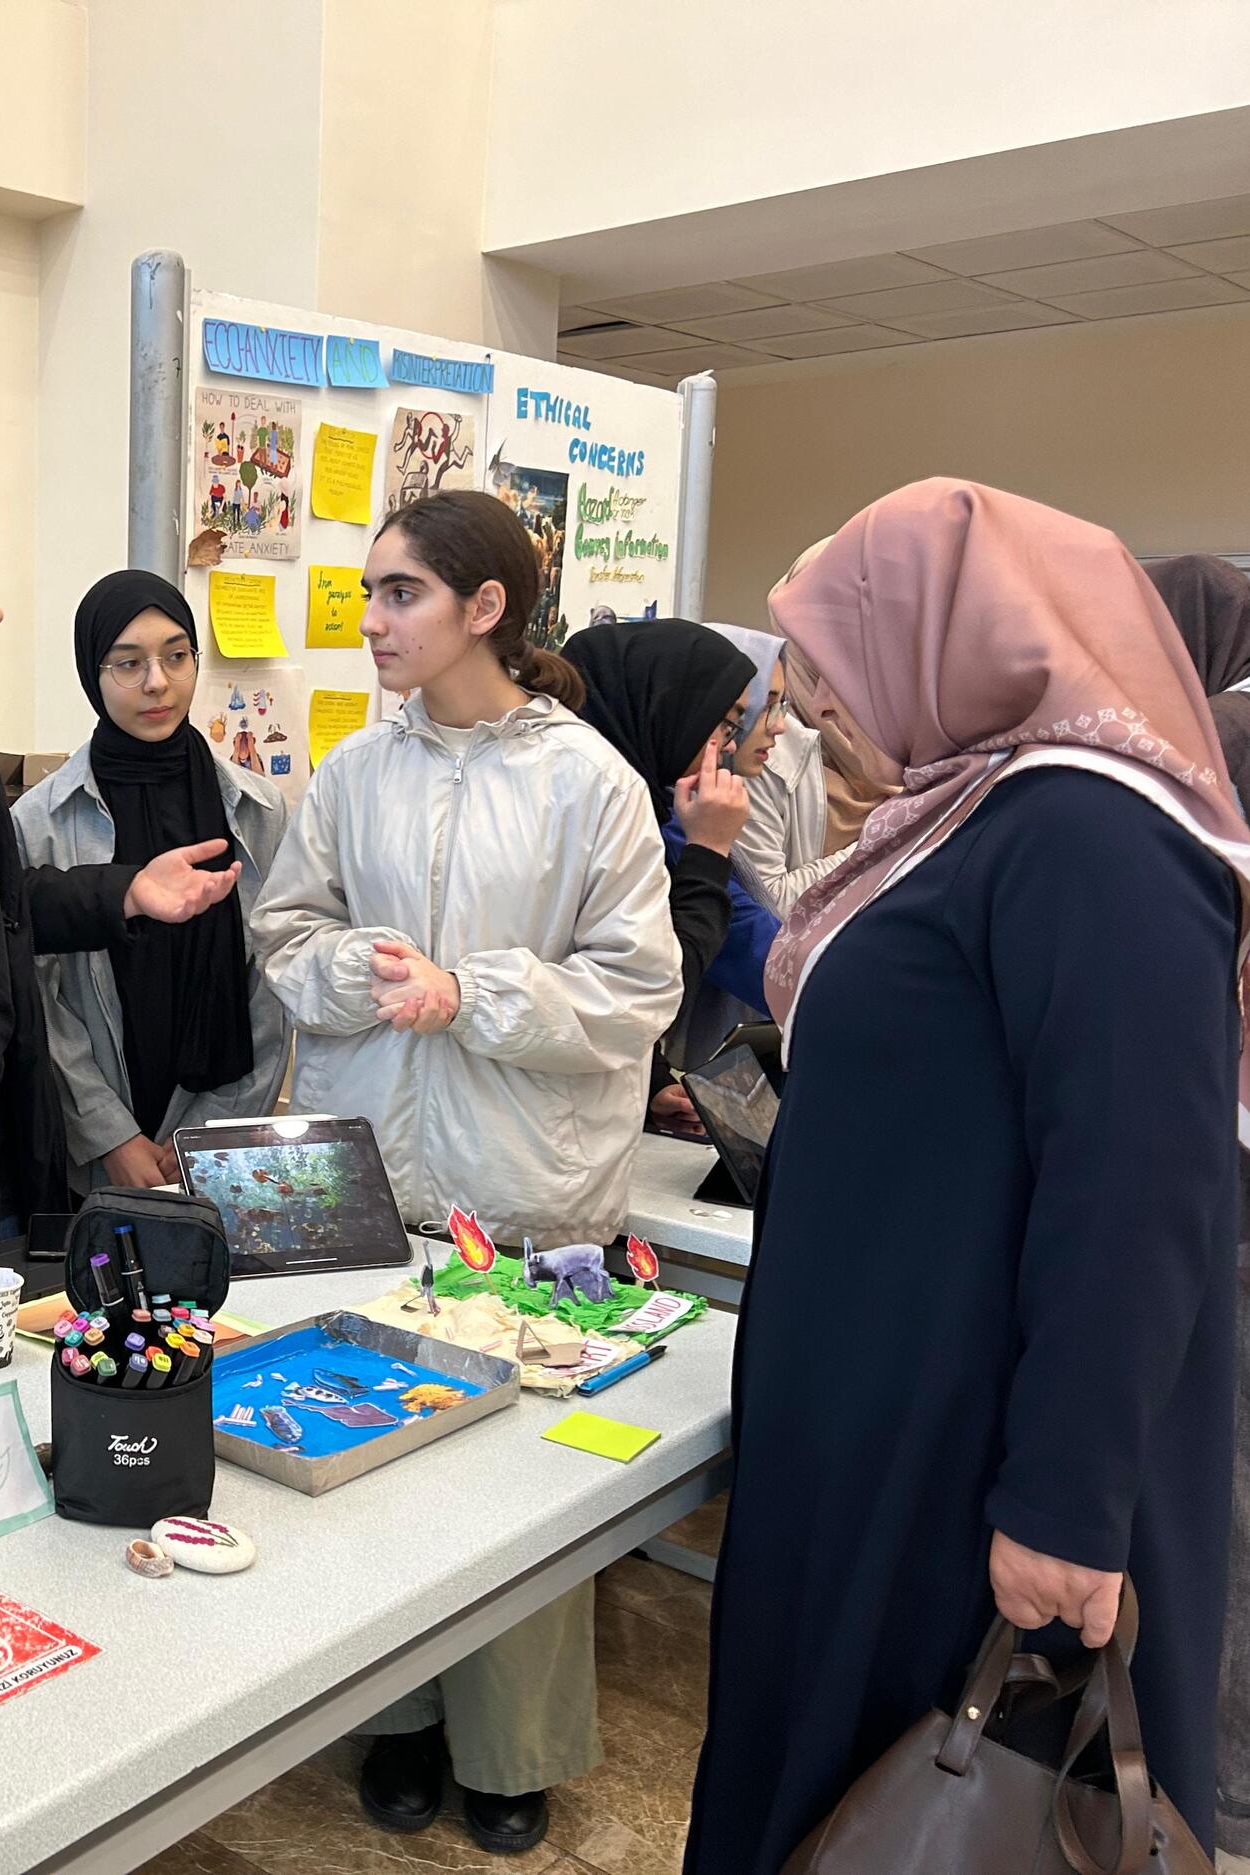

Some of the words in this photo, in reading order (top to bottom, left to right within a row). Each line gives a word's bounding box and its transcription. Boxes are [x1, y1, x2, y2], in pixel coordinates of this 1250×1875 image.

[332, 342, 380, 383] AND
[201, 391, 223, 406] HOW
[228, 394, 240, 408] TO
[244, 396, 270, 412] DEAL
[274, 400, 296, 414] WITH
[516, 387, 592, 431] ETHICAL
[568, 437, 645, 477] CONCERNS
[250, 542, 290, 555] ANXIETY
[107, 1434, 158, 1454] Touch
[113, 1453, 151, 1468] 36pcs
[12, 1648, 78, 1683] KORUYUNUZ
